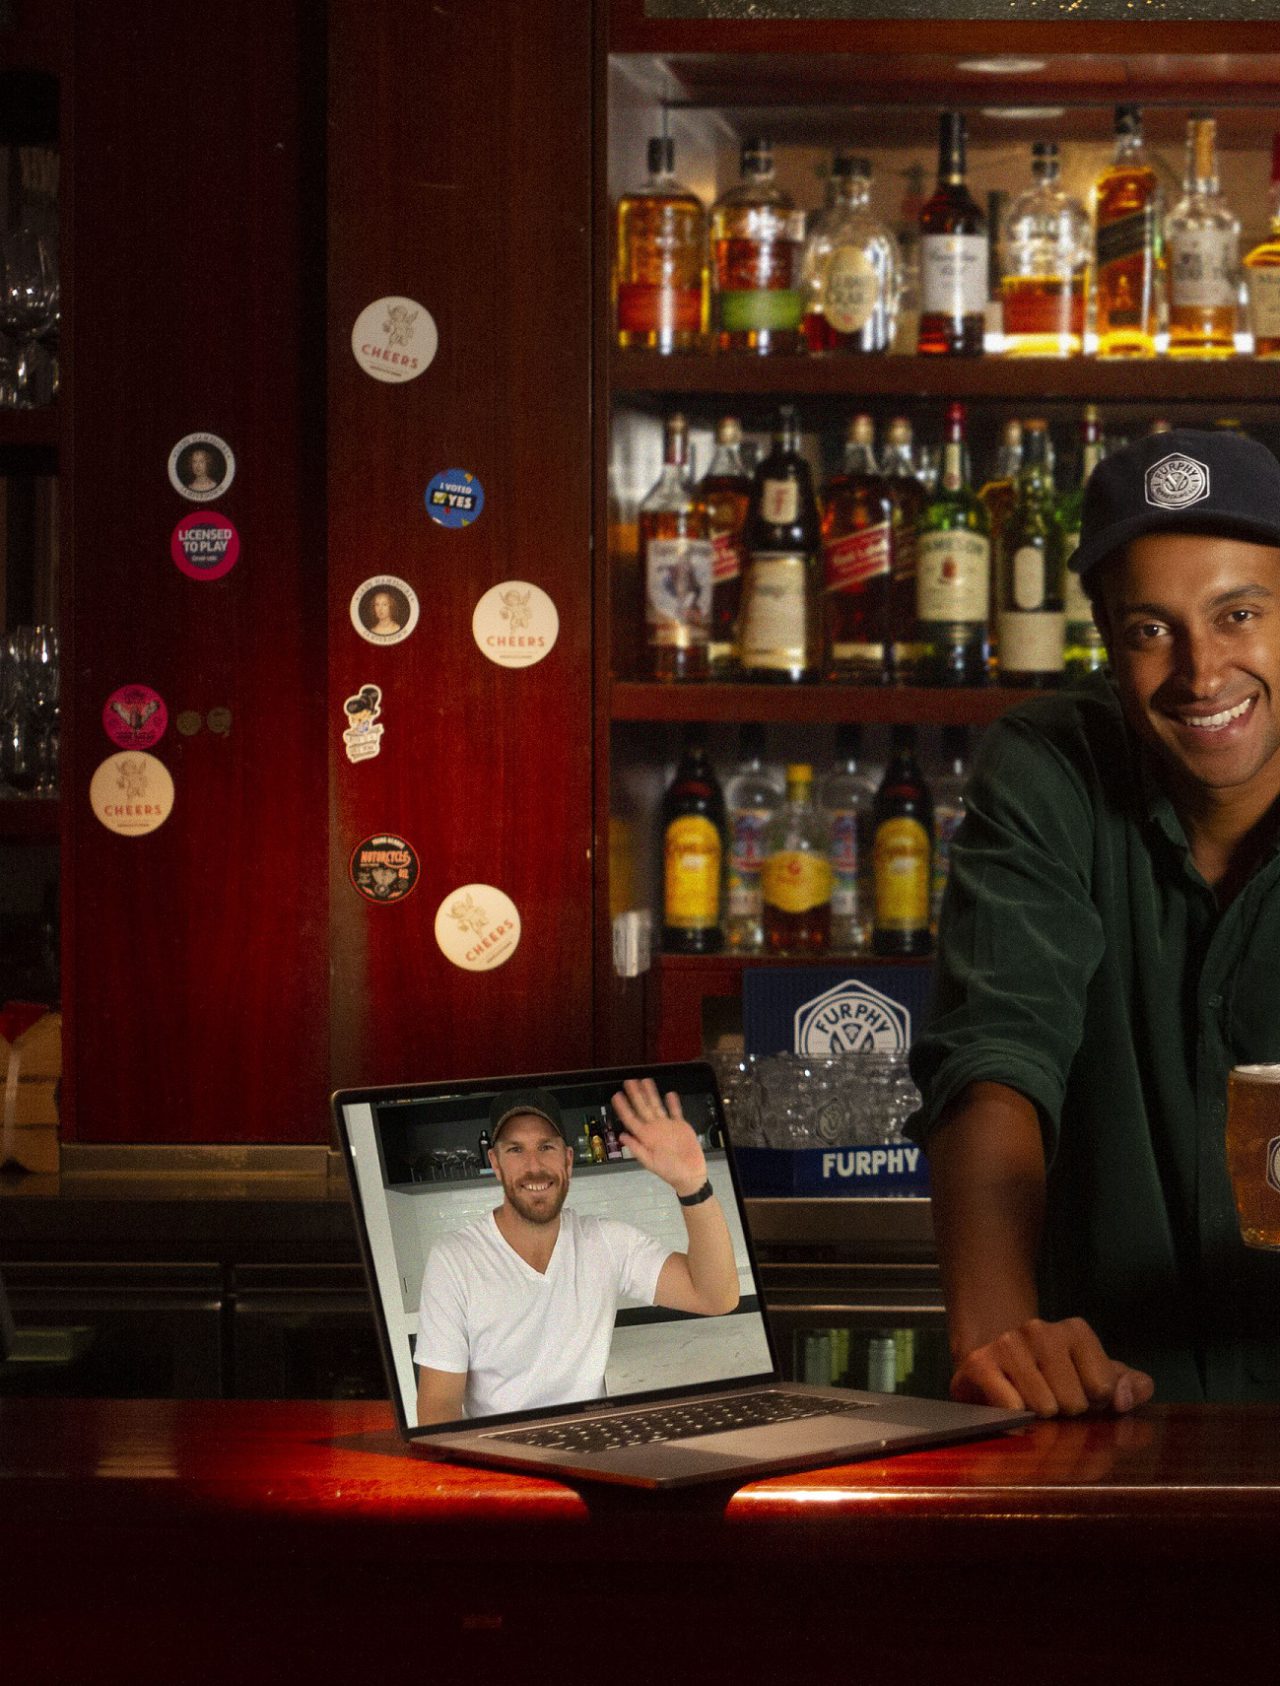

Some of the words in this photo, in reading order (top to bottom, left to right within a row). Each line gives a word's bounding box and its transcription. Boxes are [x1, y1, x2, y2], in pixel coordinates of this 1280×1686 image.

[361, 343, 418, 369] CHEERS
[1155, 462, 1198, 480] FURPHY
[448, 494, 472, 509] YES
[178, 529, 232, 541] LICENSED
[183, 541, 199, 553] TO
[200, 540, 228, 552] PLAY
[486, 635, 545, 648] CHEERS
[104, 804, 162, 817] CHEERS
[465, 919, 514, 962] CHEERS
[815, 1003, 890, 1034] FURPHY
[823, 1148, 920, 1178] FURPHY
